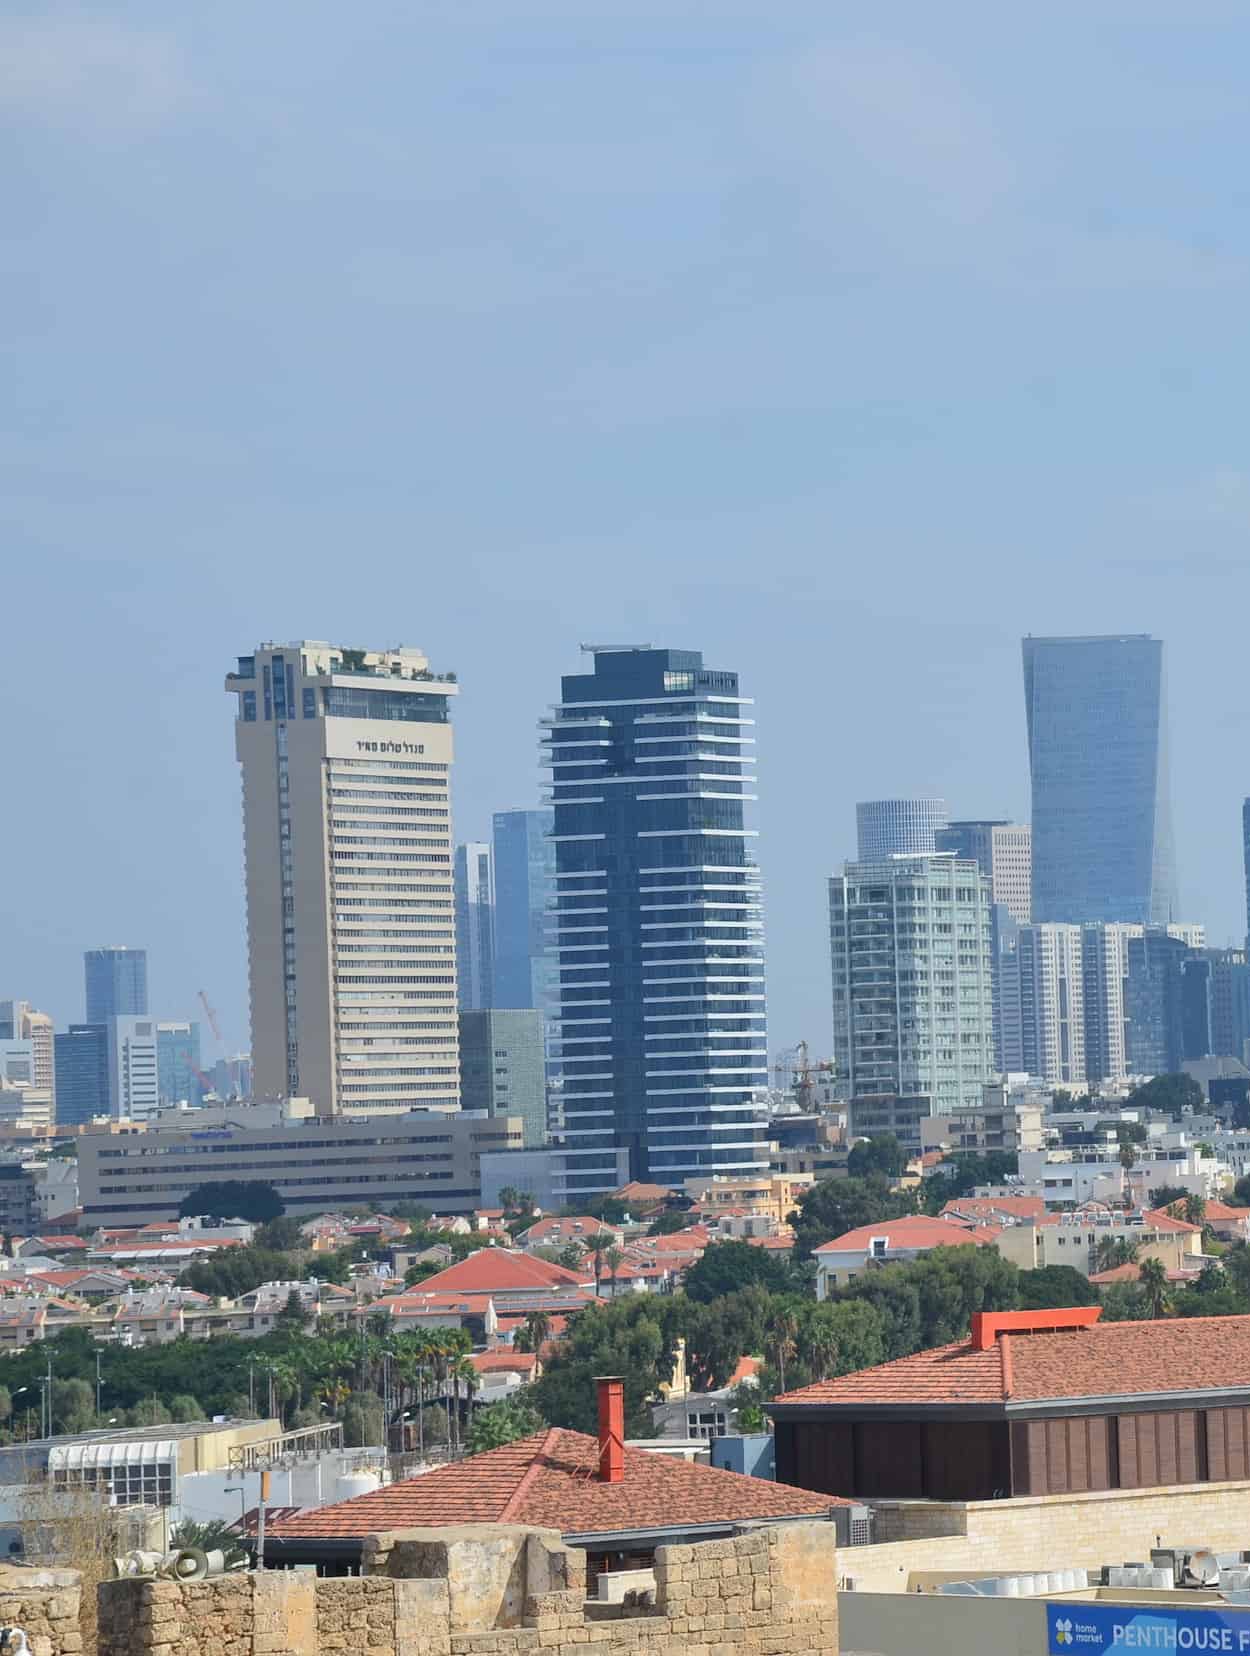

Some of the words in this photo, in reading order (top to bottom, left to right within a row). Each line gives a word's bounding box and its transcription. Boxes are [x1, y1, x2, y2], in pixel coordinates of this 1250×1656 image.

[356, 741, 378, 753] מאיר
[380, 740, 402, 754] שלום
[403, 741, 425, 754] מגדל
[1075, 1623, 1097, 1634] home
[1076, 1633, 1104, 1643] market
[1113, 1624, 1233, 1651] PENTHOUSE
